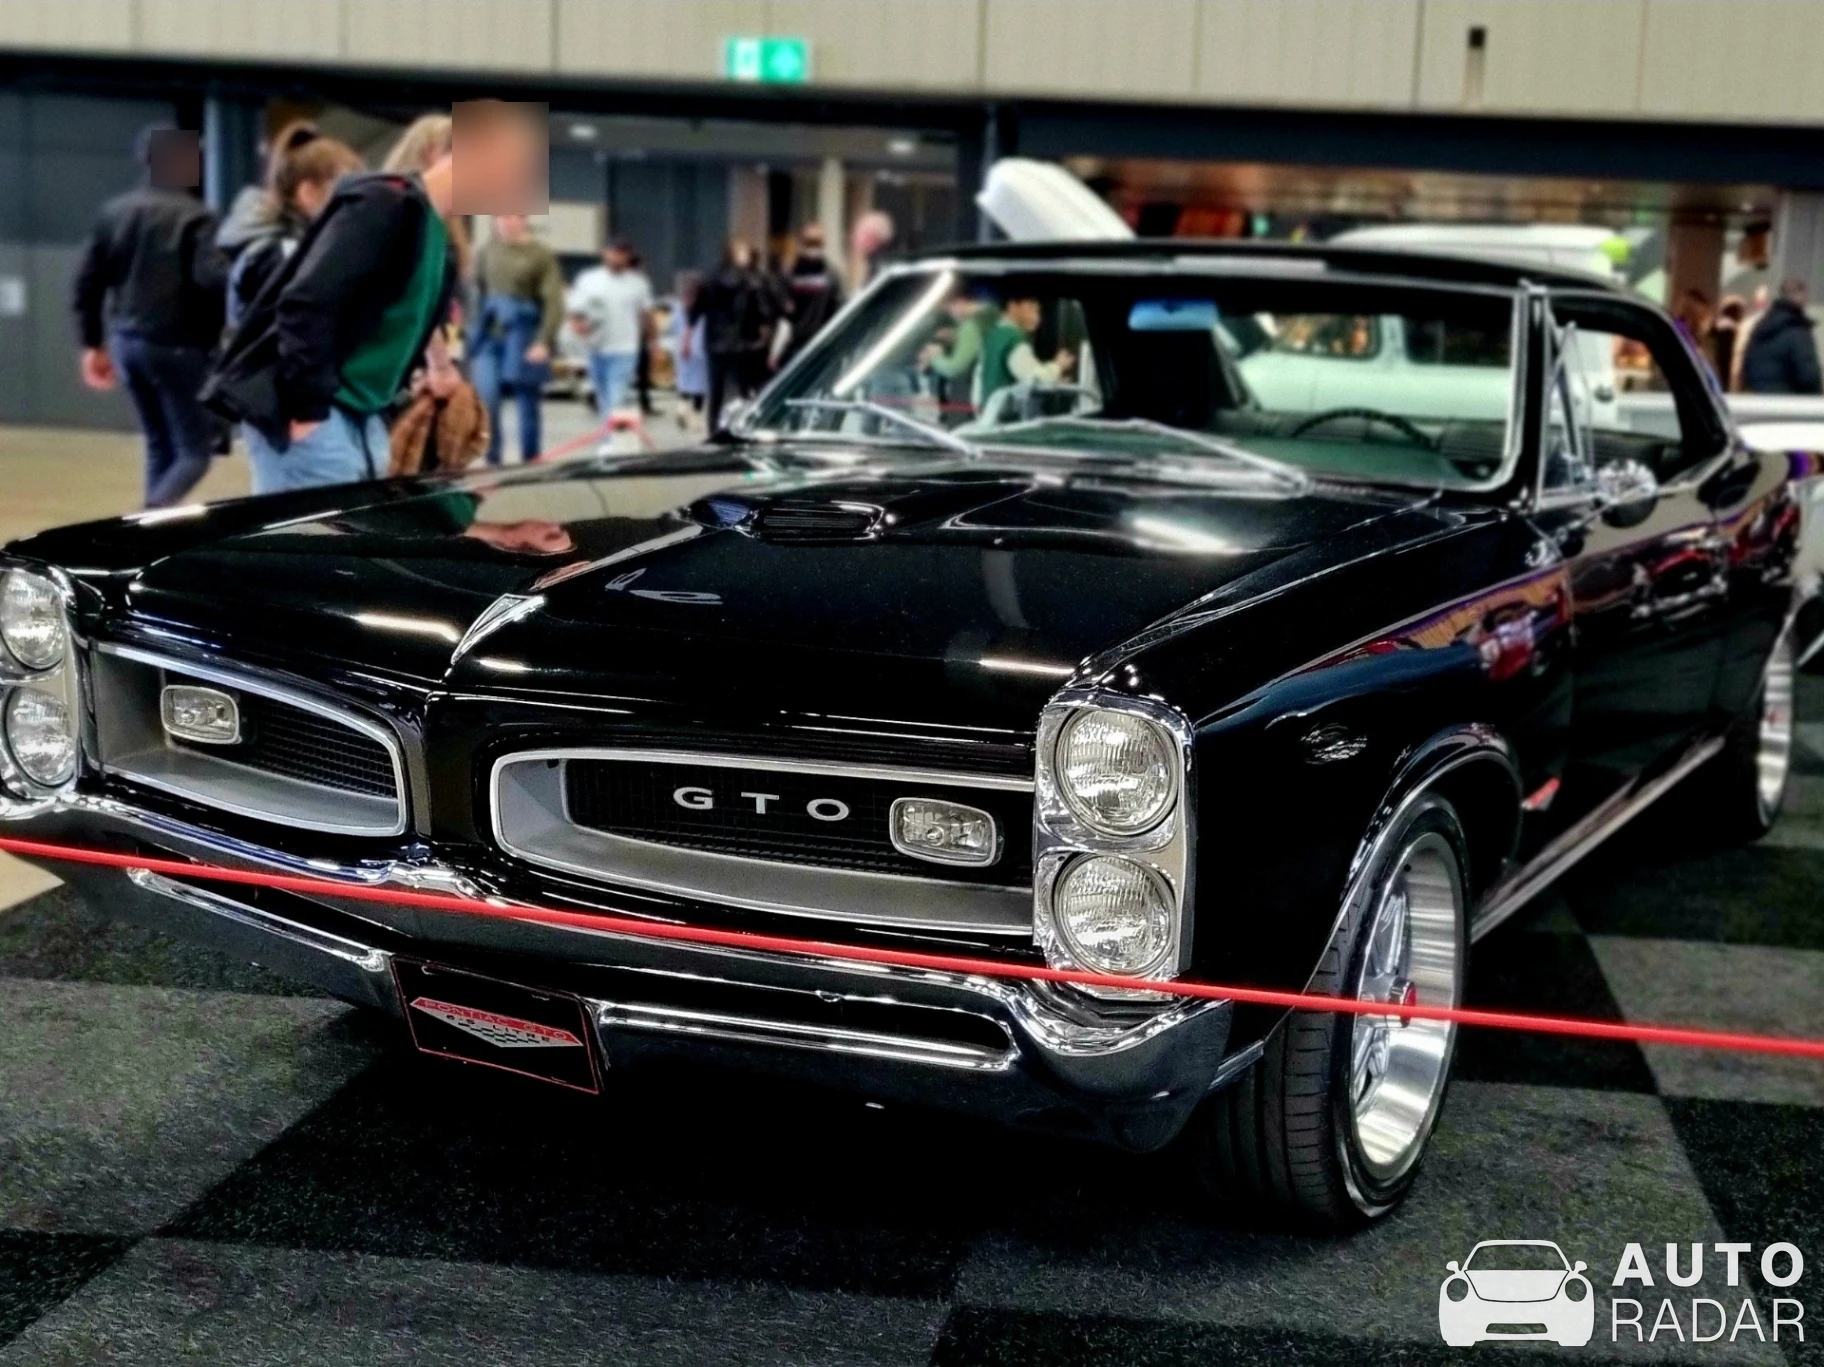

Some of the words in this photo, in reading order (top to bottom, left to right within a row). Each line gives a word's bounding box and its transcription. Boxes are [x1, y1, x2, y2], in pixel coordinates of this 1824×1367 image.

[673, 786, 850, 821] GTO
[424, 999, 508, 1026] PONTIAC
[523, 1023, 568, 1040] GTO
[492, 1024, 551, 1042] LITRE
